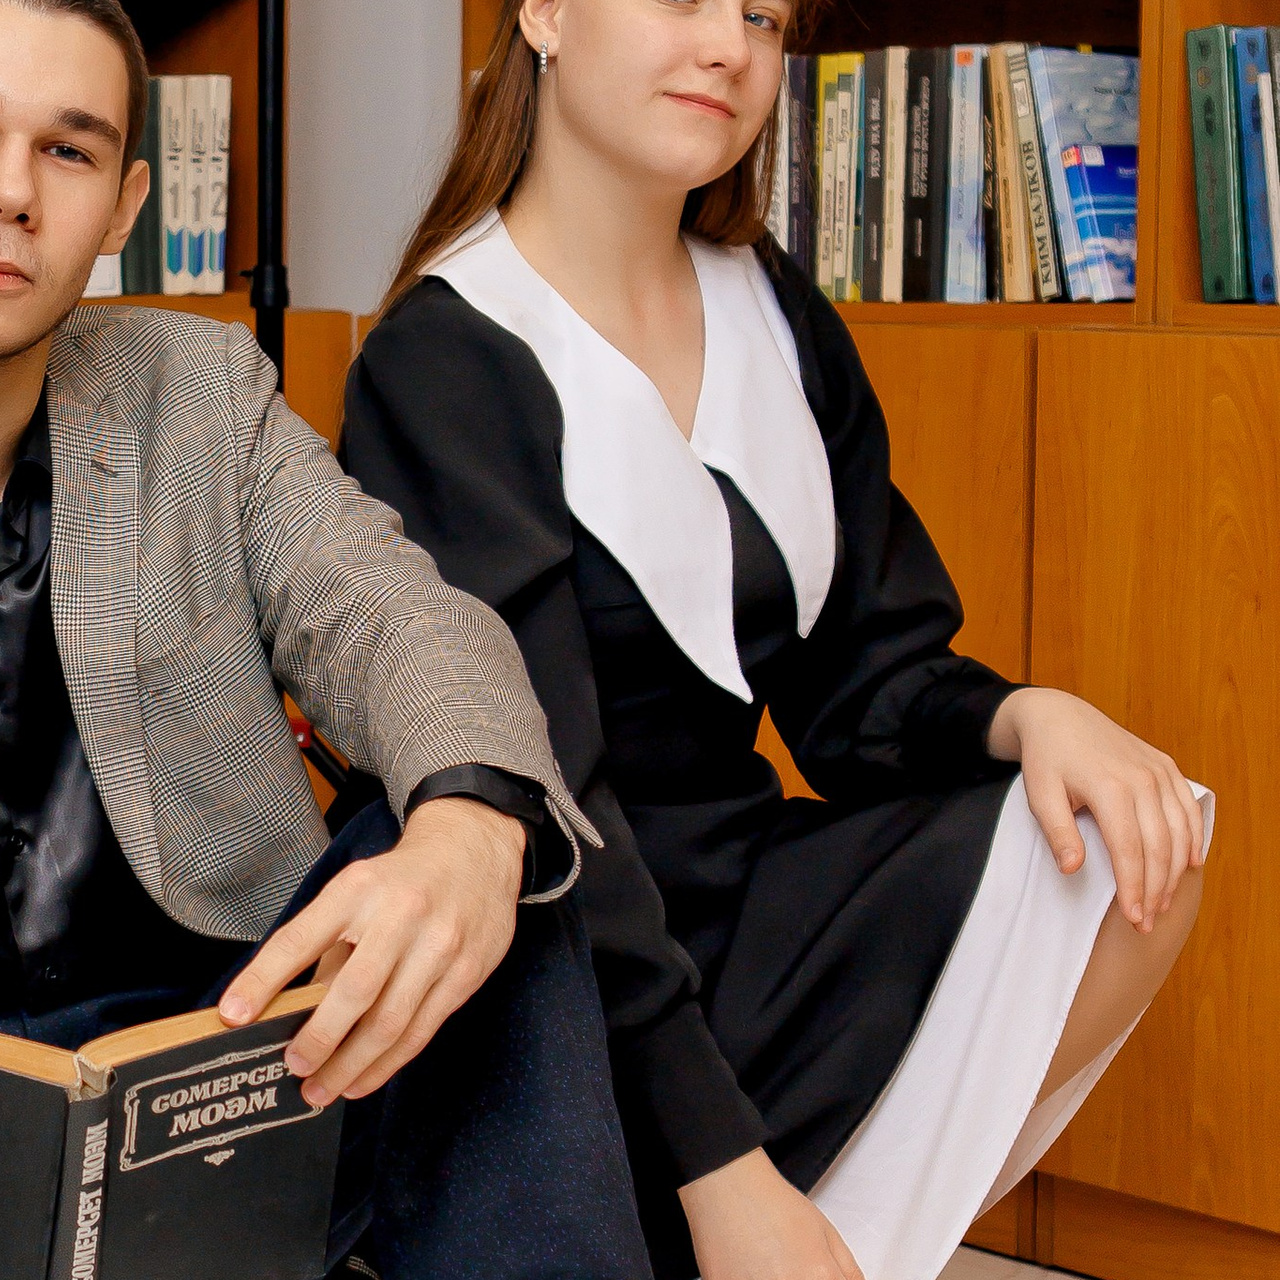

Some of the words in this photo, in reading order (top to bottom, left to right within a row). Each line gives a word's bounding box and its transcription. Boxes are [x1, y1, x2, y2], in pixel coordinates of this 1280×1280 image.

[1022, 139, 1045, 230] БАЛКОВ
[1033, 236, 1052, 286] КИМ
[151, 1061, 293, 1114] СОМЕРСЕ
[168, 1086, 278, 1138] МОЭМ
[81, 1118, 109, 1186] МОЭМ
